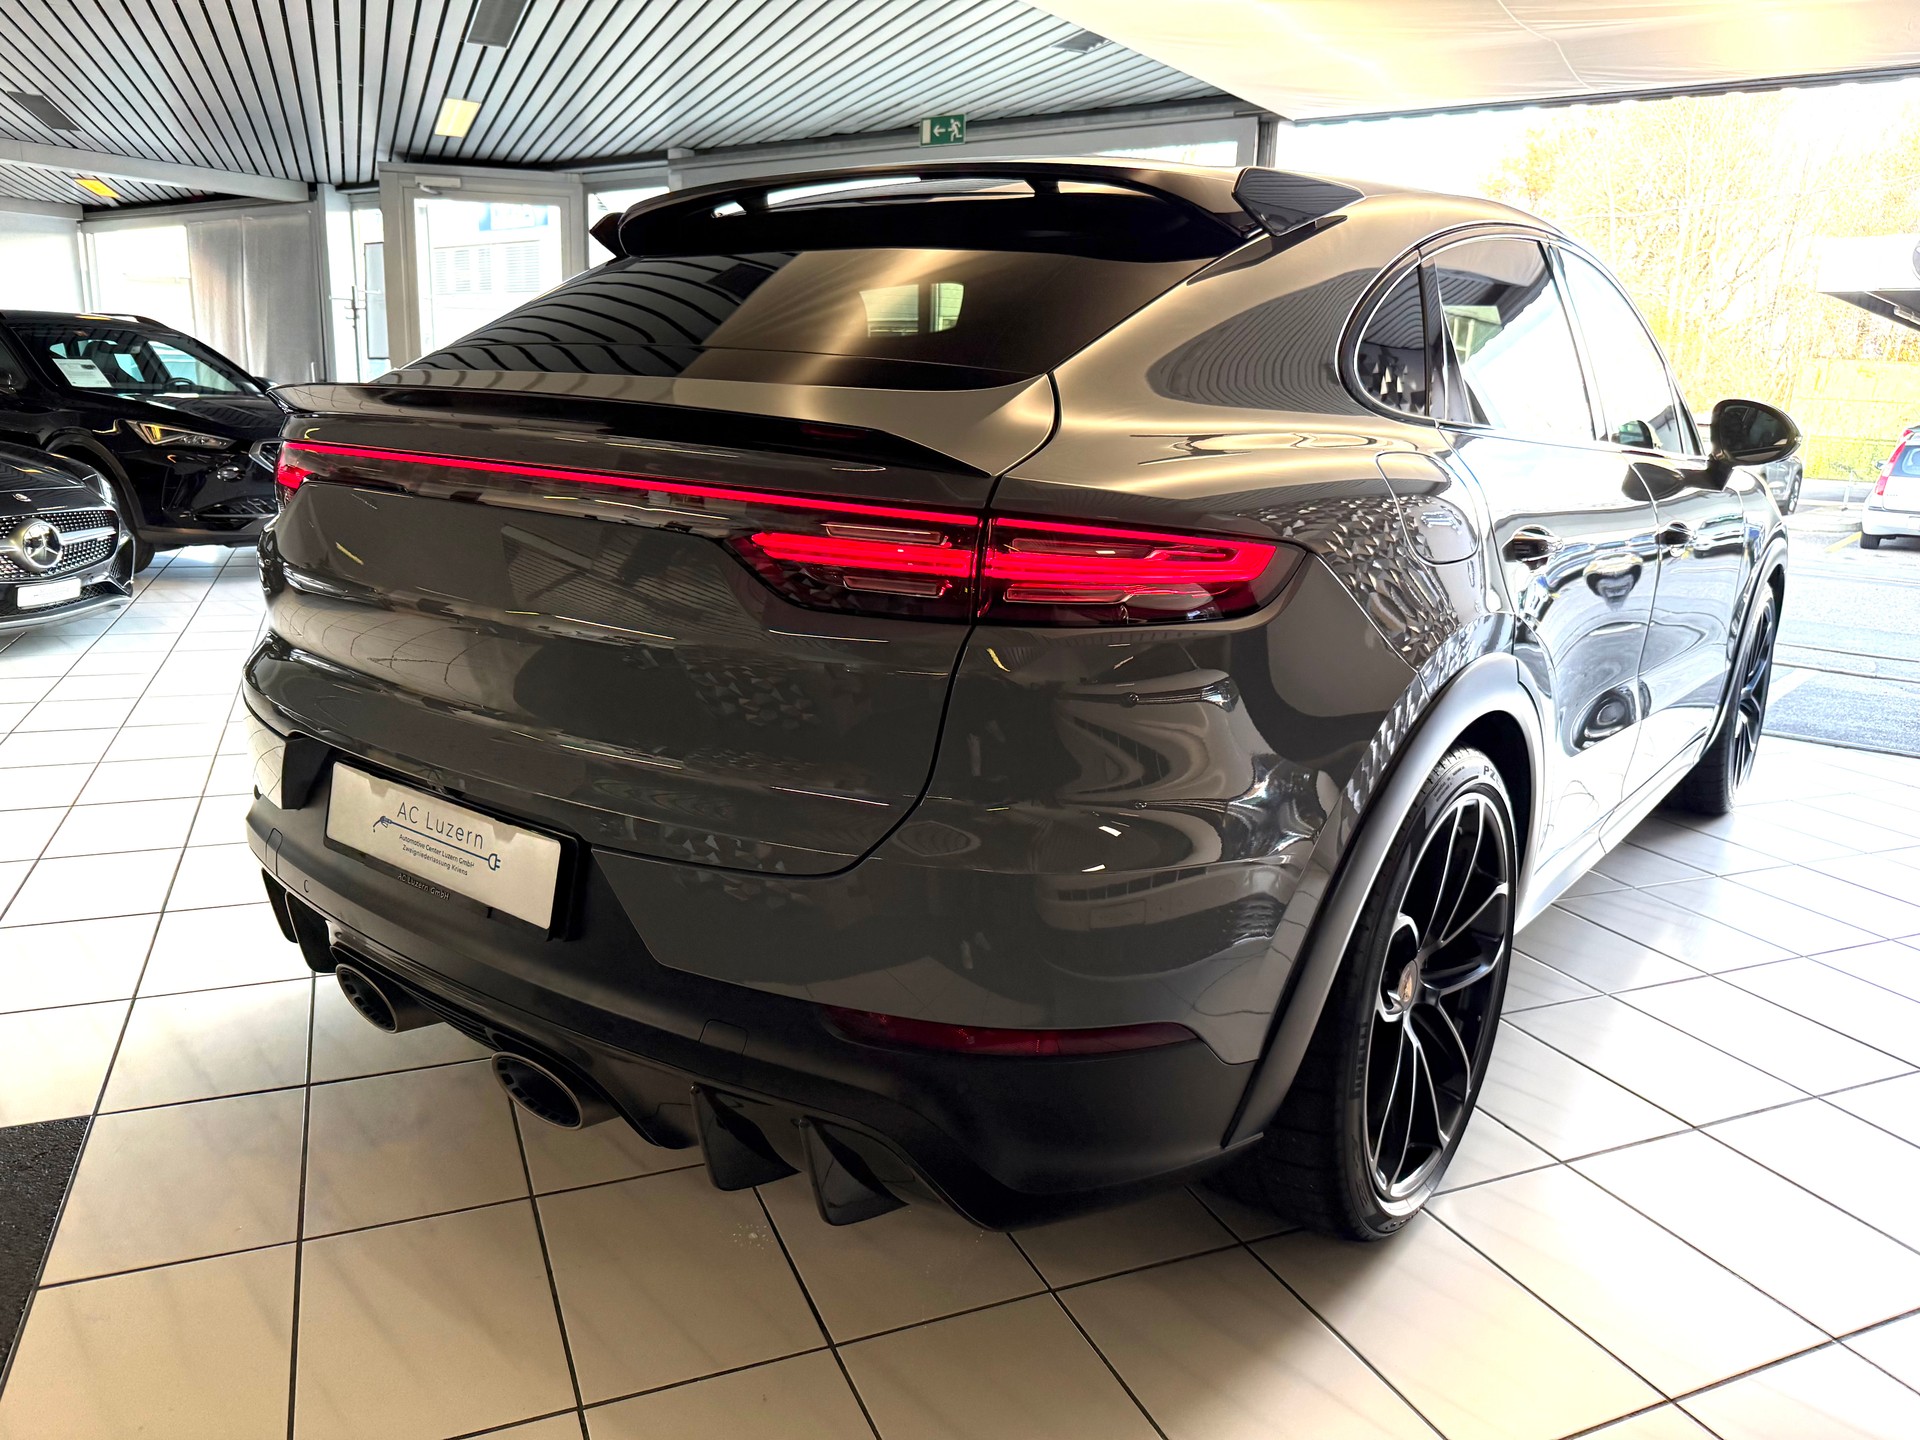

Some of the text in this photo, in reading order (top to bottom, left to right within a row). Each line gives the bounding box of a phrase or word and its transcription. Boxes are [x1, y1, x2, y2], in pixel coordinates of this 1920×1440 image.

[396, 801, 484, 850] AC Luzern
[399, 833, 475, 869] Automotive Center Luzern GmbH
[402, 844, 468, 876] Zweigniederlassung Kriens
[397, 872, 450, 900] AC Luzern GmbH
